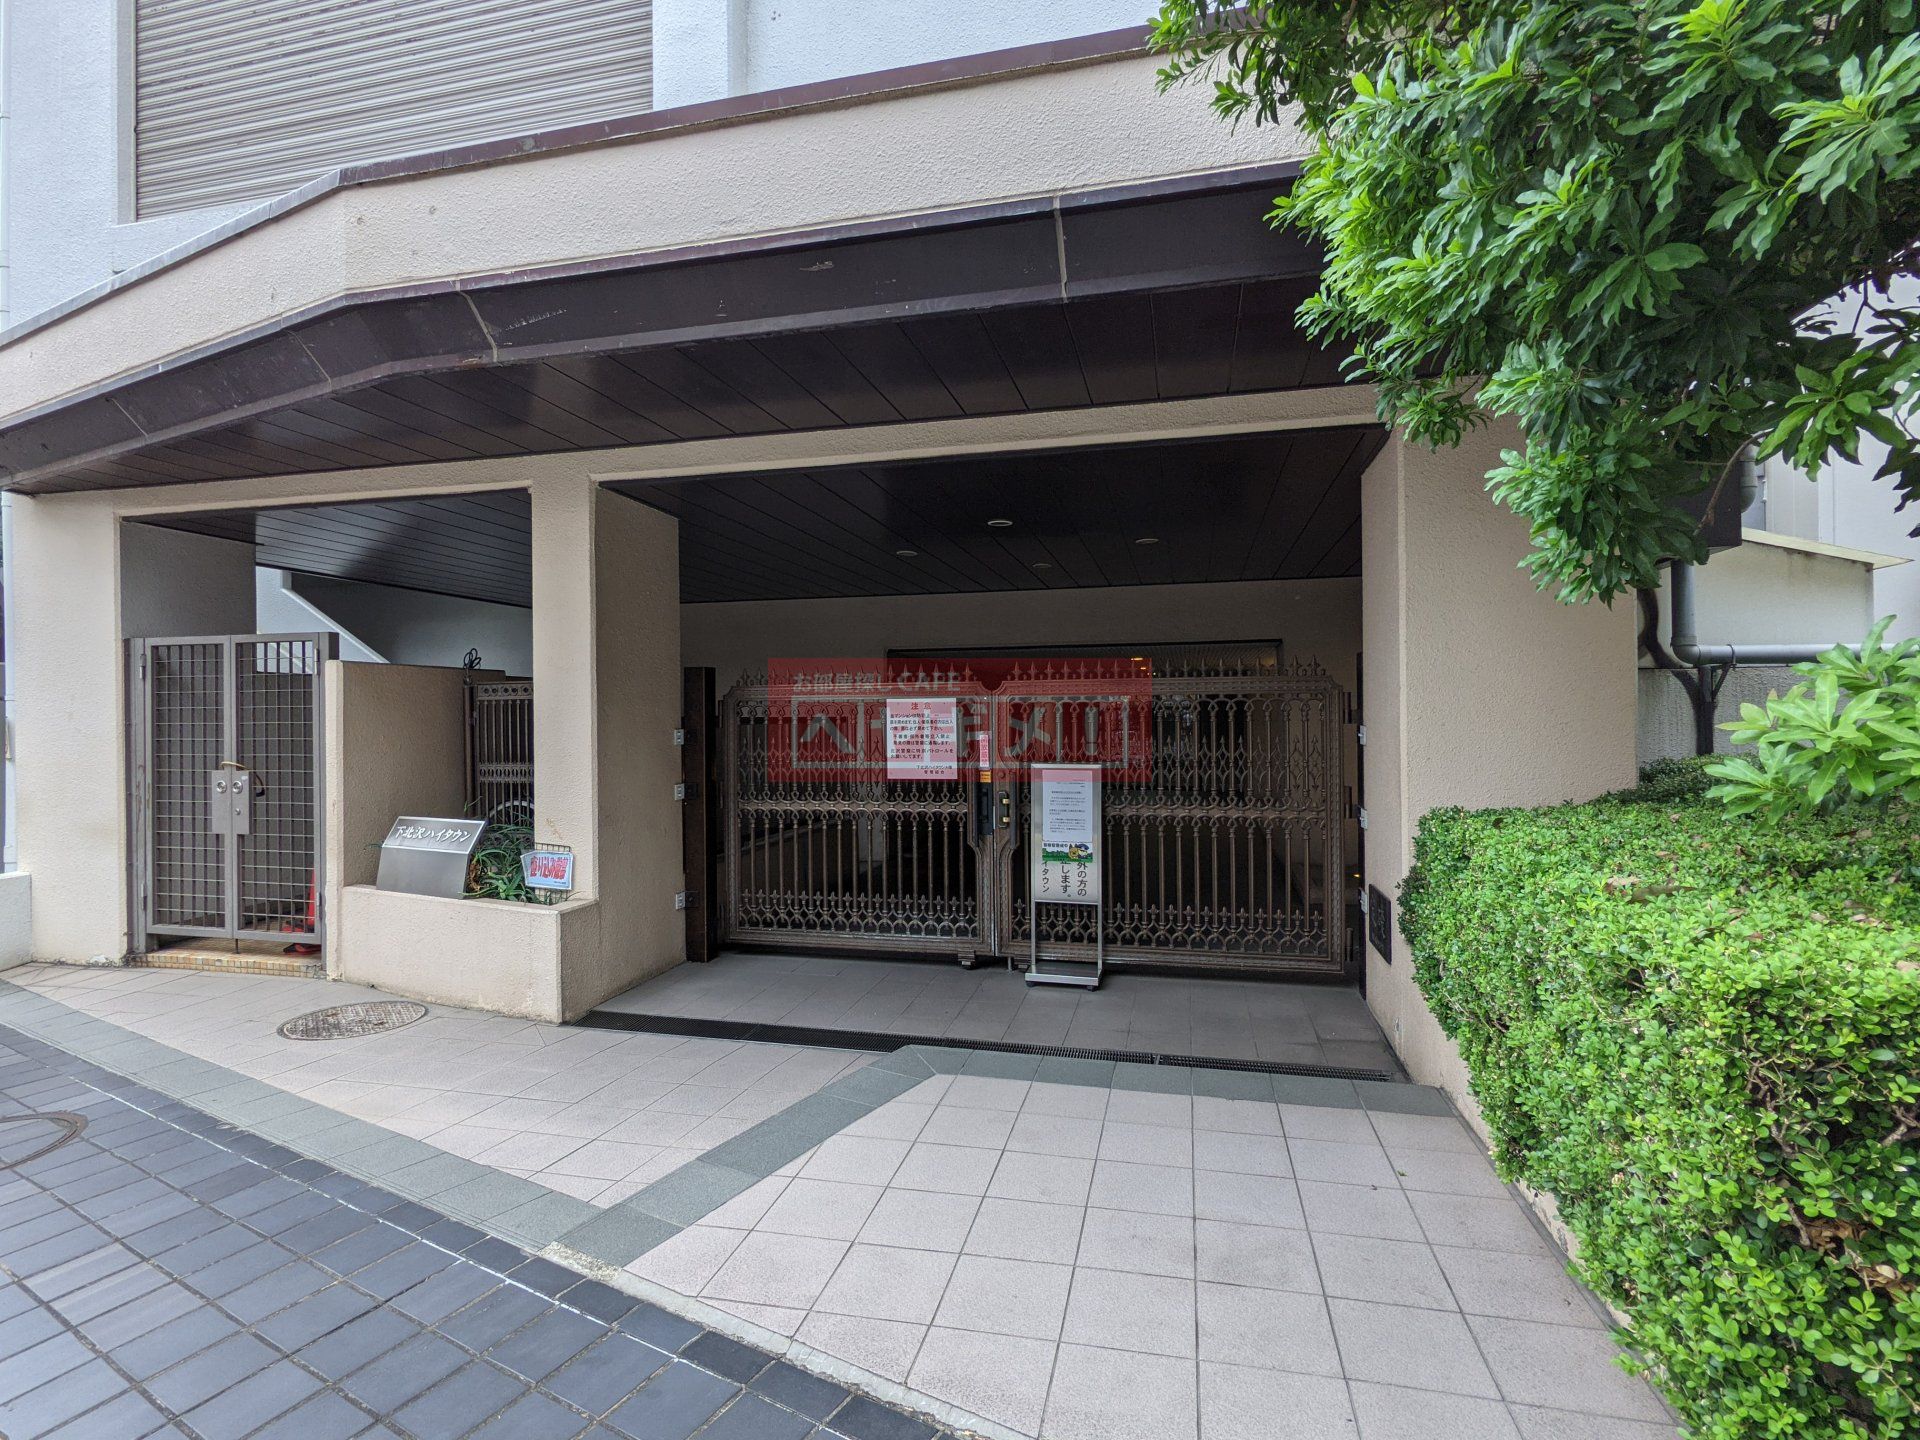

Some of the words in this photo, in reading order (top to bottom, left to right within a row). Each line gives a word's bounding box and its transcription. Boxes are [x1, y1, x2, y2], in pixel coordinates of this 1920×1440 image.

[911, 702, 932, 710] 注意
[395, 826, 472, 842] 下北沢ハイタウン
[1077, 861, 1088, 897] 外の方の
